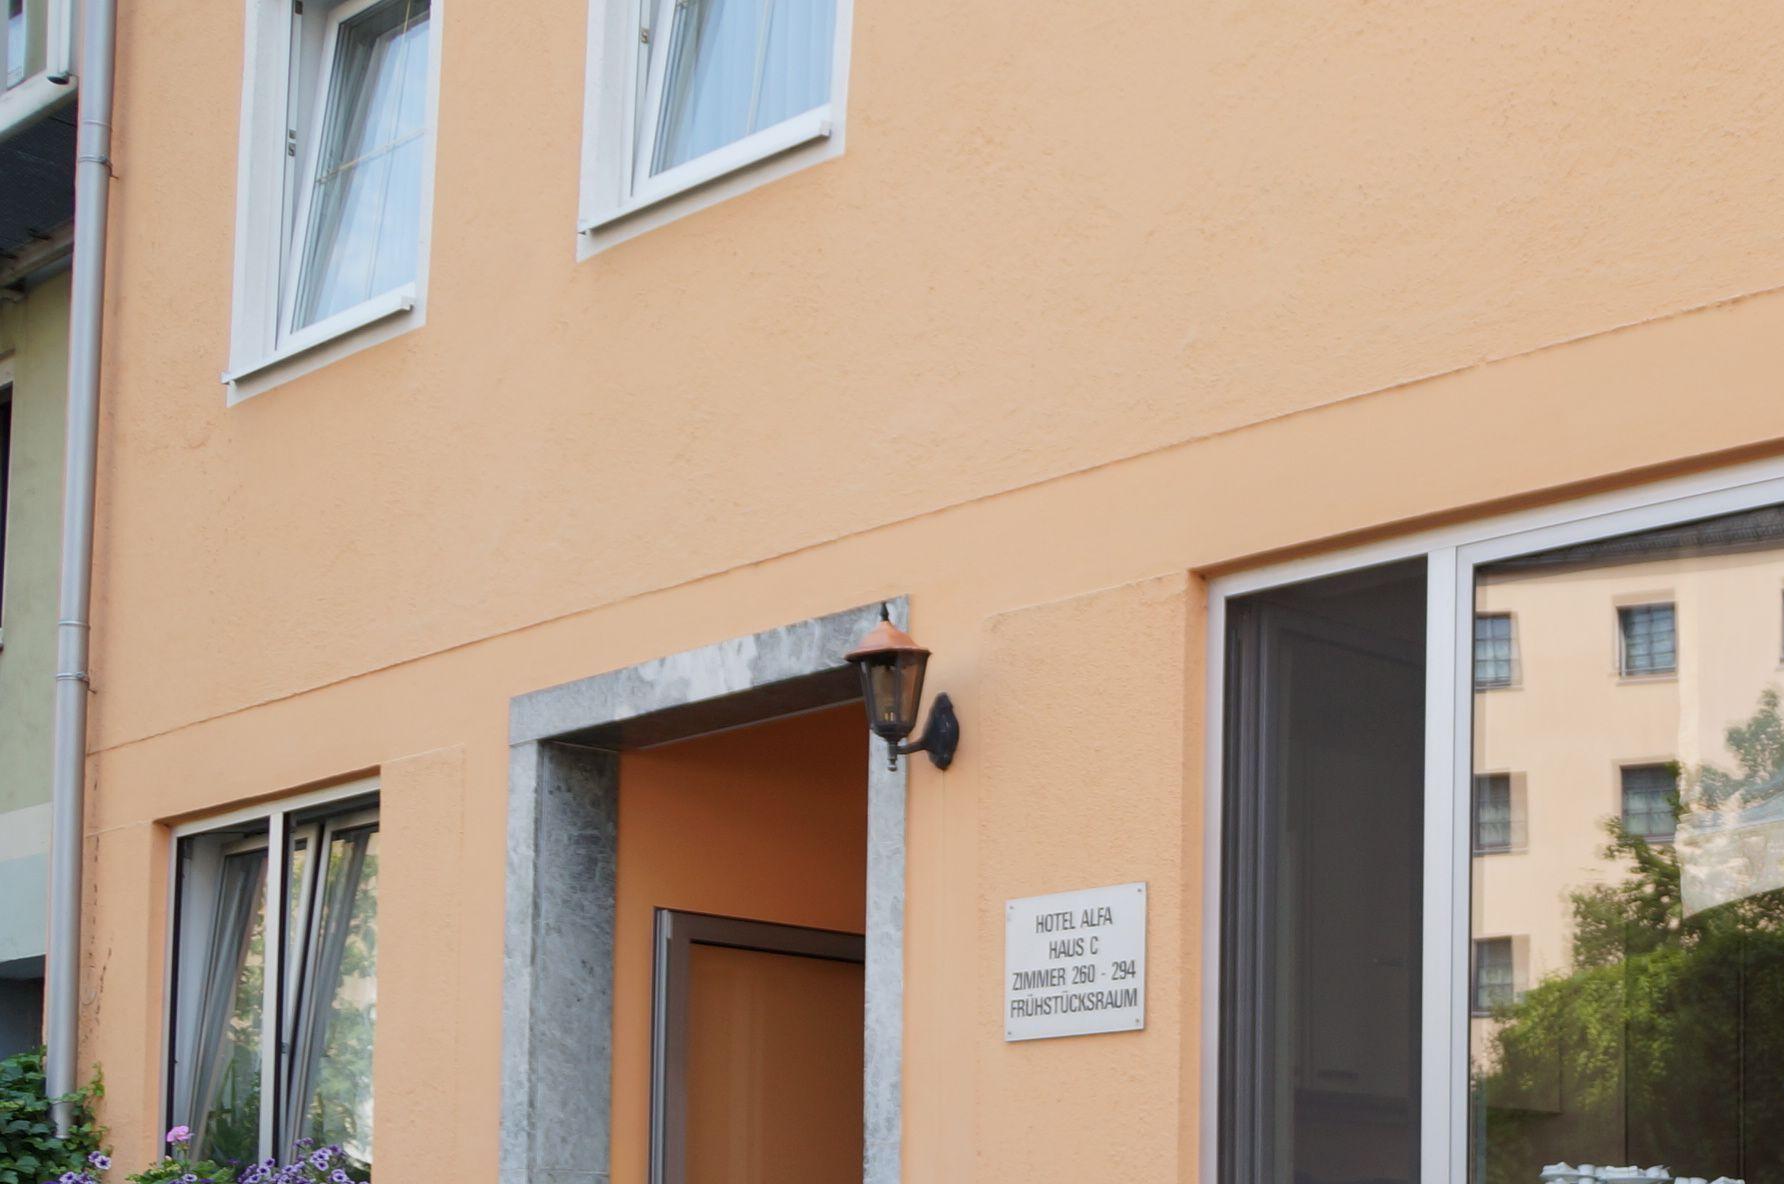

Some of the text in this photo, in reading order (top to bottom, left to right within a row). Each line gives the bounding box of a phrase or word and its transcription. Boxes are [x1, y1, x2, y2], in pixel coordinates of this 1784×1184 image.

[1036, 906, 1113, 933] HOTEL ALFA
[1049, 936, 1099, 959] HAUS C
[1012, 967, 1066, 991] ZIMMER
[1072, 964, 1095, 985] 260
[1111, 960, 1136, 981] 294
[1010, 988, 1138, 1018] FRÜHSTÜCKSRAUM
